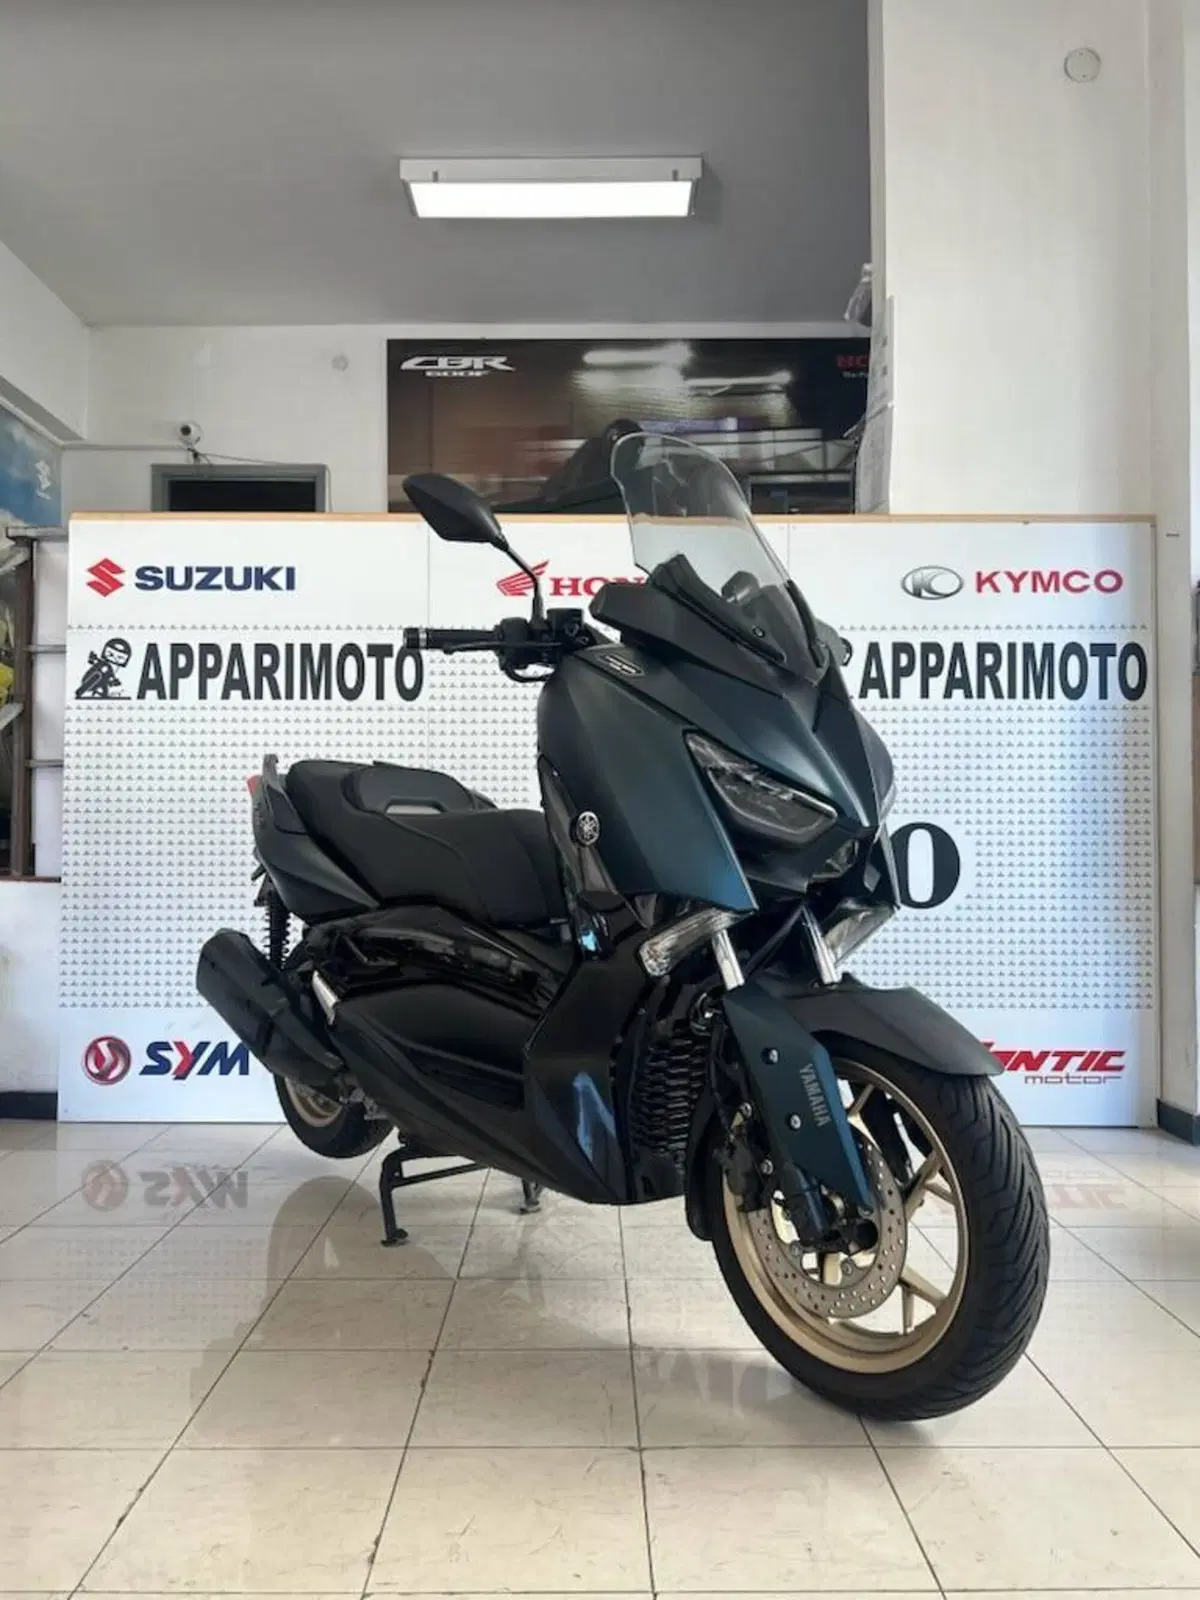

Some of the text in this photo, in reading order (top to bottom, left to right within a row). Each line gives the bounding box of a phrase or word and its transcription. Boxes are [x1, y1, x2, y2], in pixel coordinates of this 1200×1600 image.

[400, 355, 516, 372] CBR
[134, 565, 296, 591] SUZUKI
[975, 569, 1123, 593] KYMCO
[137, 642, 425, 701] APPARIMOTO
[858, 641, 1148, 701] APPARIMOTO
[138, 1041, 249, 1081] SYM
[799, 1062, 832, 1128] YAMAHA
[1024, 1074, 1122, 1085] motor
